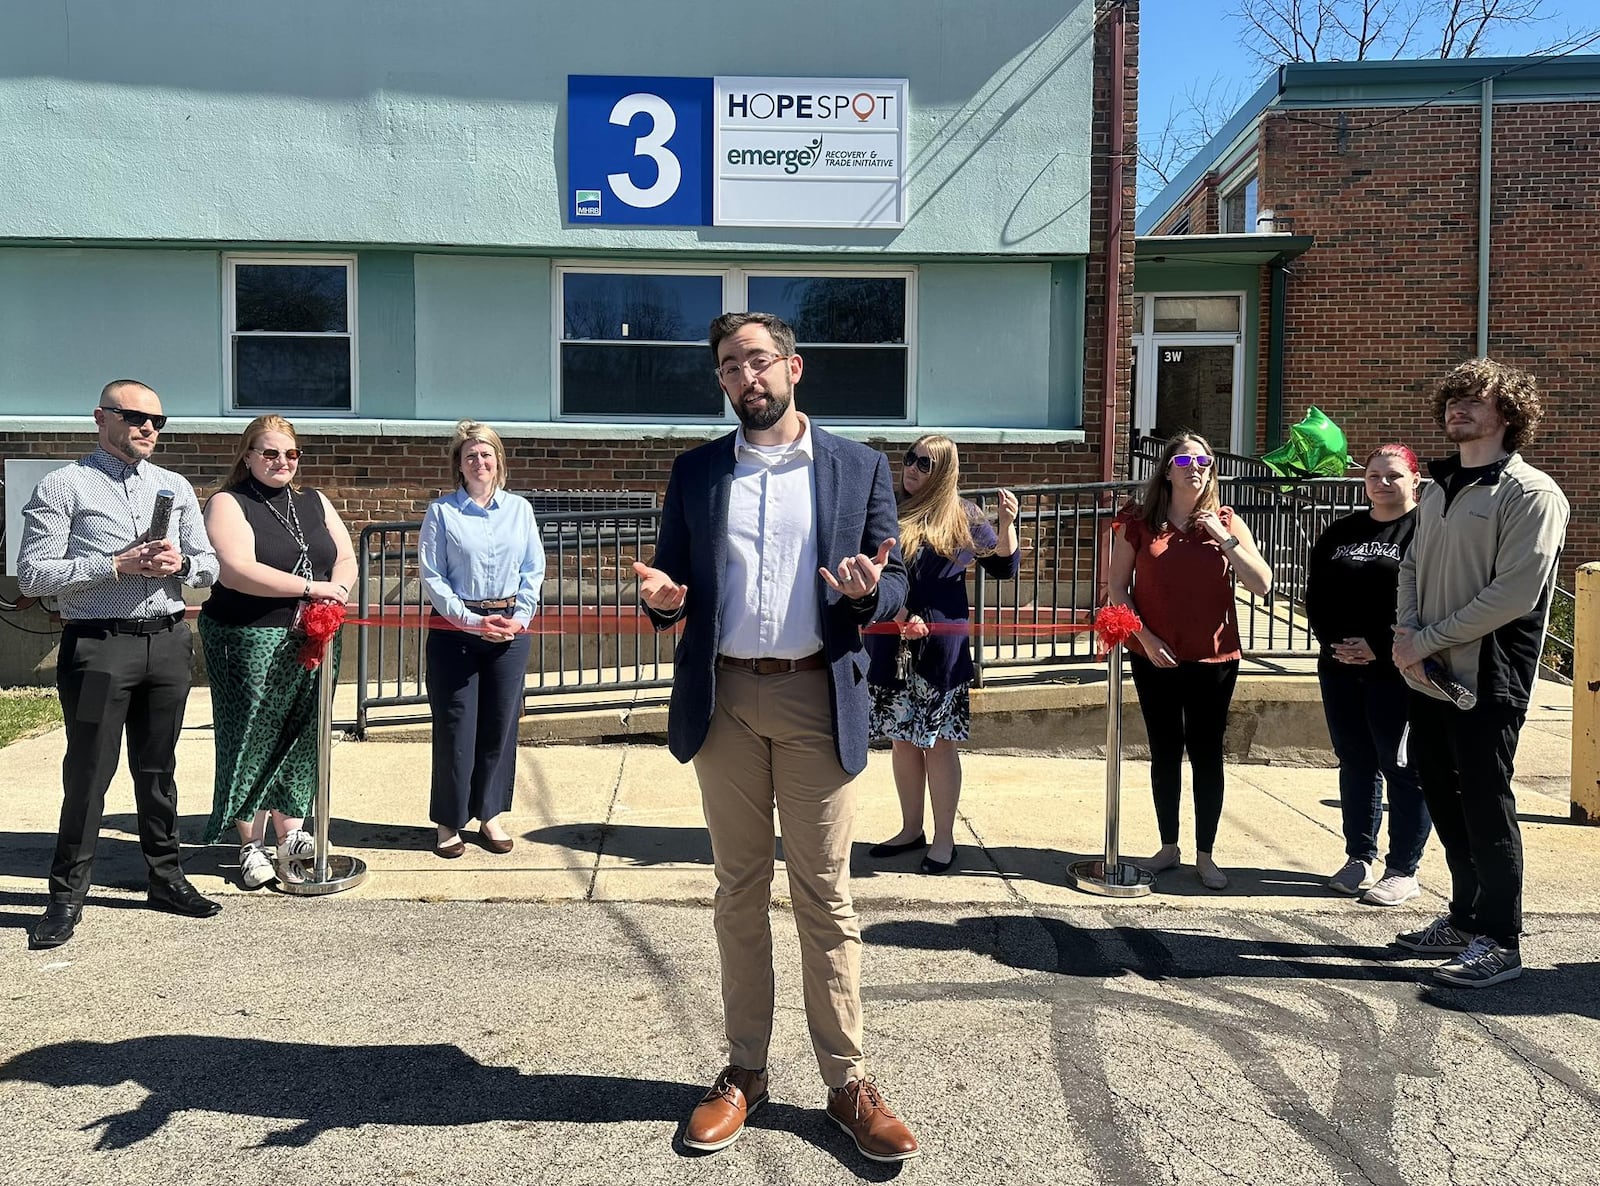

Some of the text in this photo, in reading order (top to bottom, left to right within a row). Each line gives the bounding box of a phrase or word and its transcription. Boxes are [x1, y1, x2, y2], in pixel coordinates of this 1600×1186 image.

[607, 92, 682, 208] 3
[825, 150, 878, 159] RECOVERY &
[727, 148, 812, 175] emerge
[825, 158, 894, 167] TRADE INITIATIVE
[578, 206, 600, 215] MHRB
[1163, 351, 1182, 362] 3W
[1331, 541, 1401, 561] MAMA
[1478, 952, 1505, 974] N
